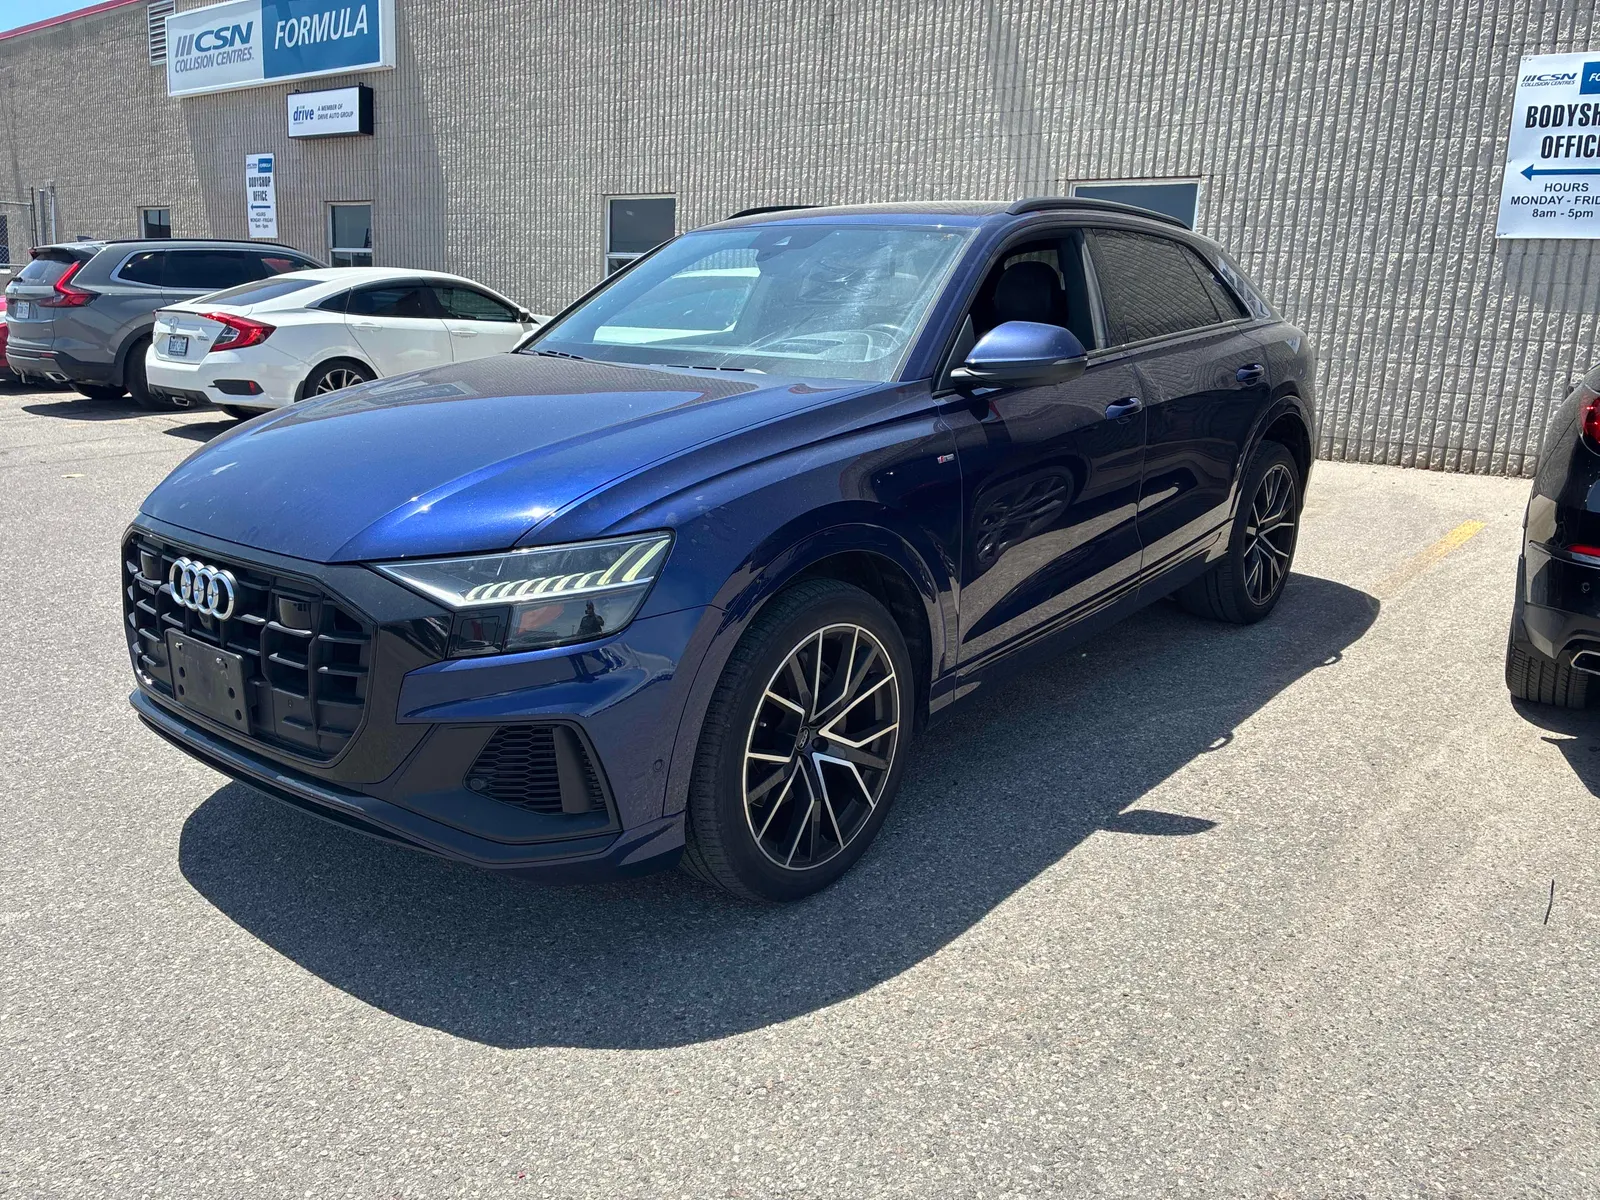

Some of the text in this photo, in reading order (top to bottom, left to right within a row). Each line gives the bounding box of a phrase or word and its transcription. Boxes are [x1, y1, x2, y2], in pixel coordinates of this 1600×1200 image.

[274, 4, 368, 50] FORMULA
[194, 20, 254, 52] CSN
[174, 53, 215, 73] COLLISION
[1536, 72, 1578, 81] CSN
[293, 106, 314, 121] drive
[1540, 134, 1600, 159] OFFIC
[248, 176, 271, 188] BODYSHOP
[1544, 182, 1589, 192] HOURS
[253, 190, 268, 202] OFFICE
[1510, 195, 1564, 205] MONDAY
[1531, 208, 1557, 218] 8am
[1567, 208, 1594, 220] 5pm
